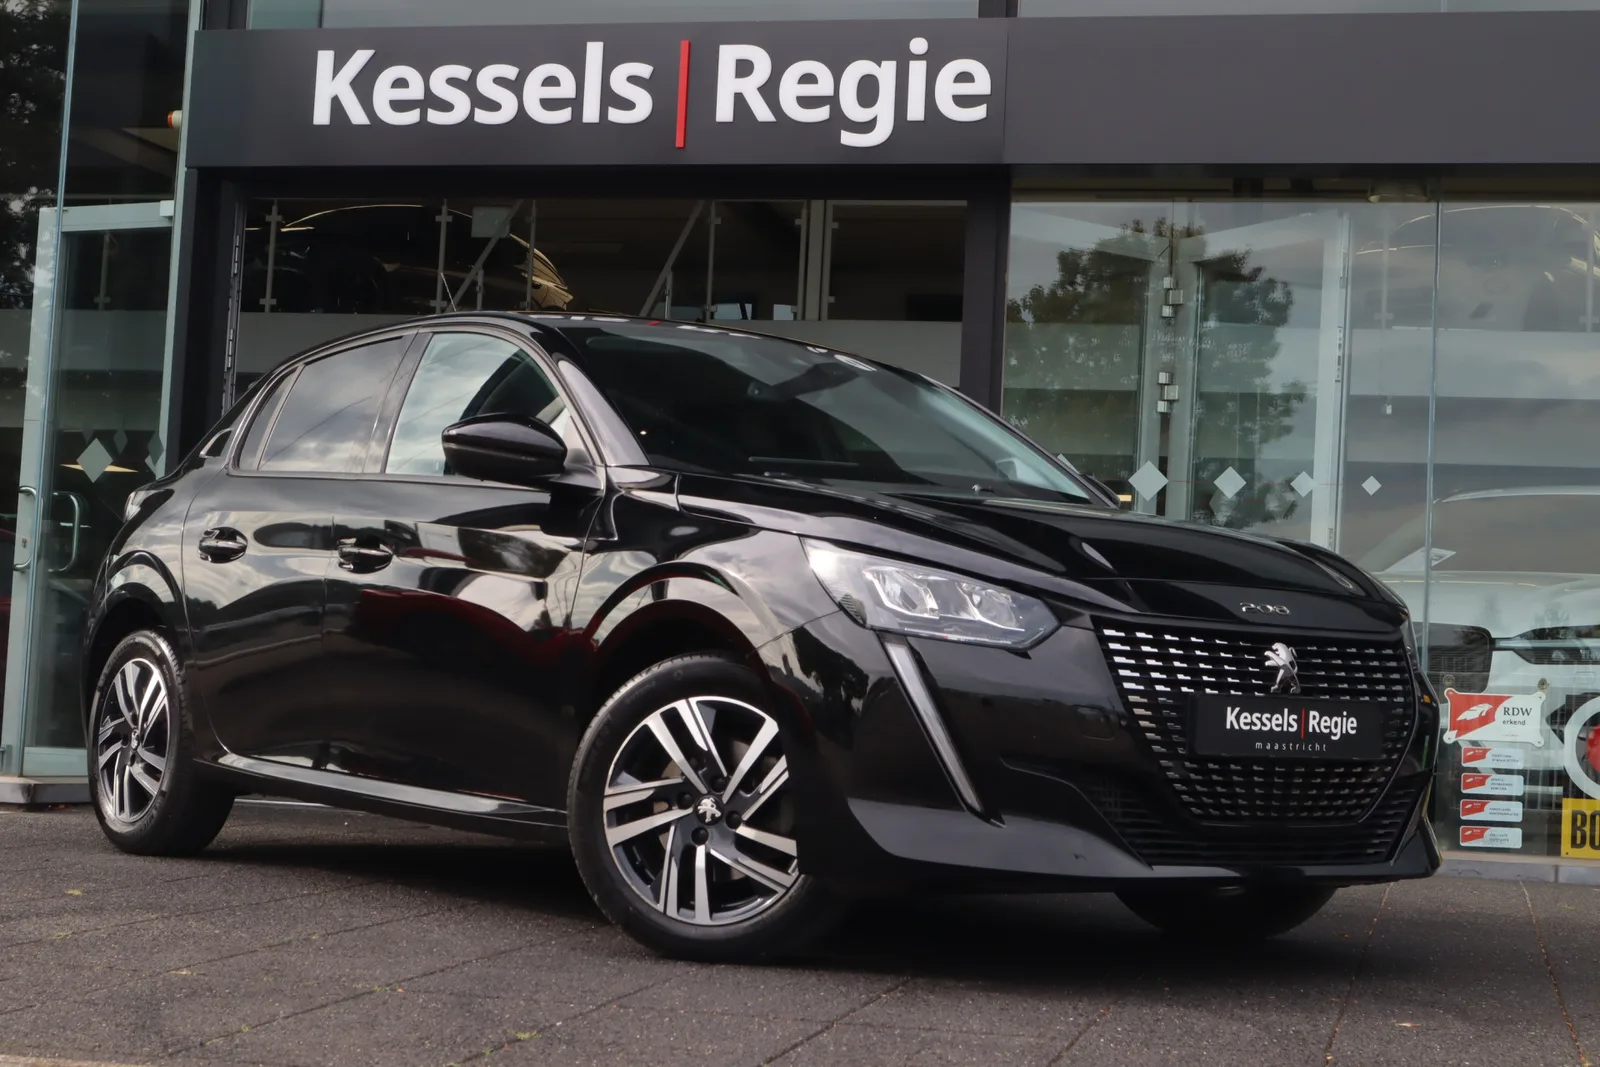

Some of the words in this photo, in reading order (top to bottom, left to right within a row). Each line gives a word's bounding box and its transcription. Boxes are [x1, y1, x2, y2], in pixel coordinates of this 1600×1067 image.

[312, 41, 654, 126] Kessels
[715, 37, 992, 148] Regie
[1239, 602, 1291, 615] 208
[1503, 706, 1533, 717] RDW
[1225, 706, 1298, 733] Kessels
[1308, 710, 1358, 741] Regie
[1255, 741, 1327, 752] maastricht
